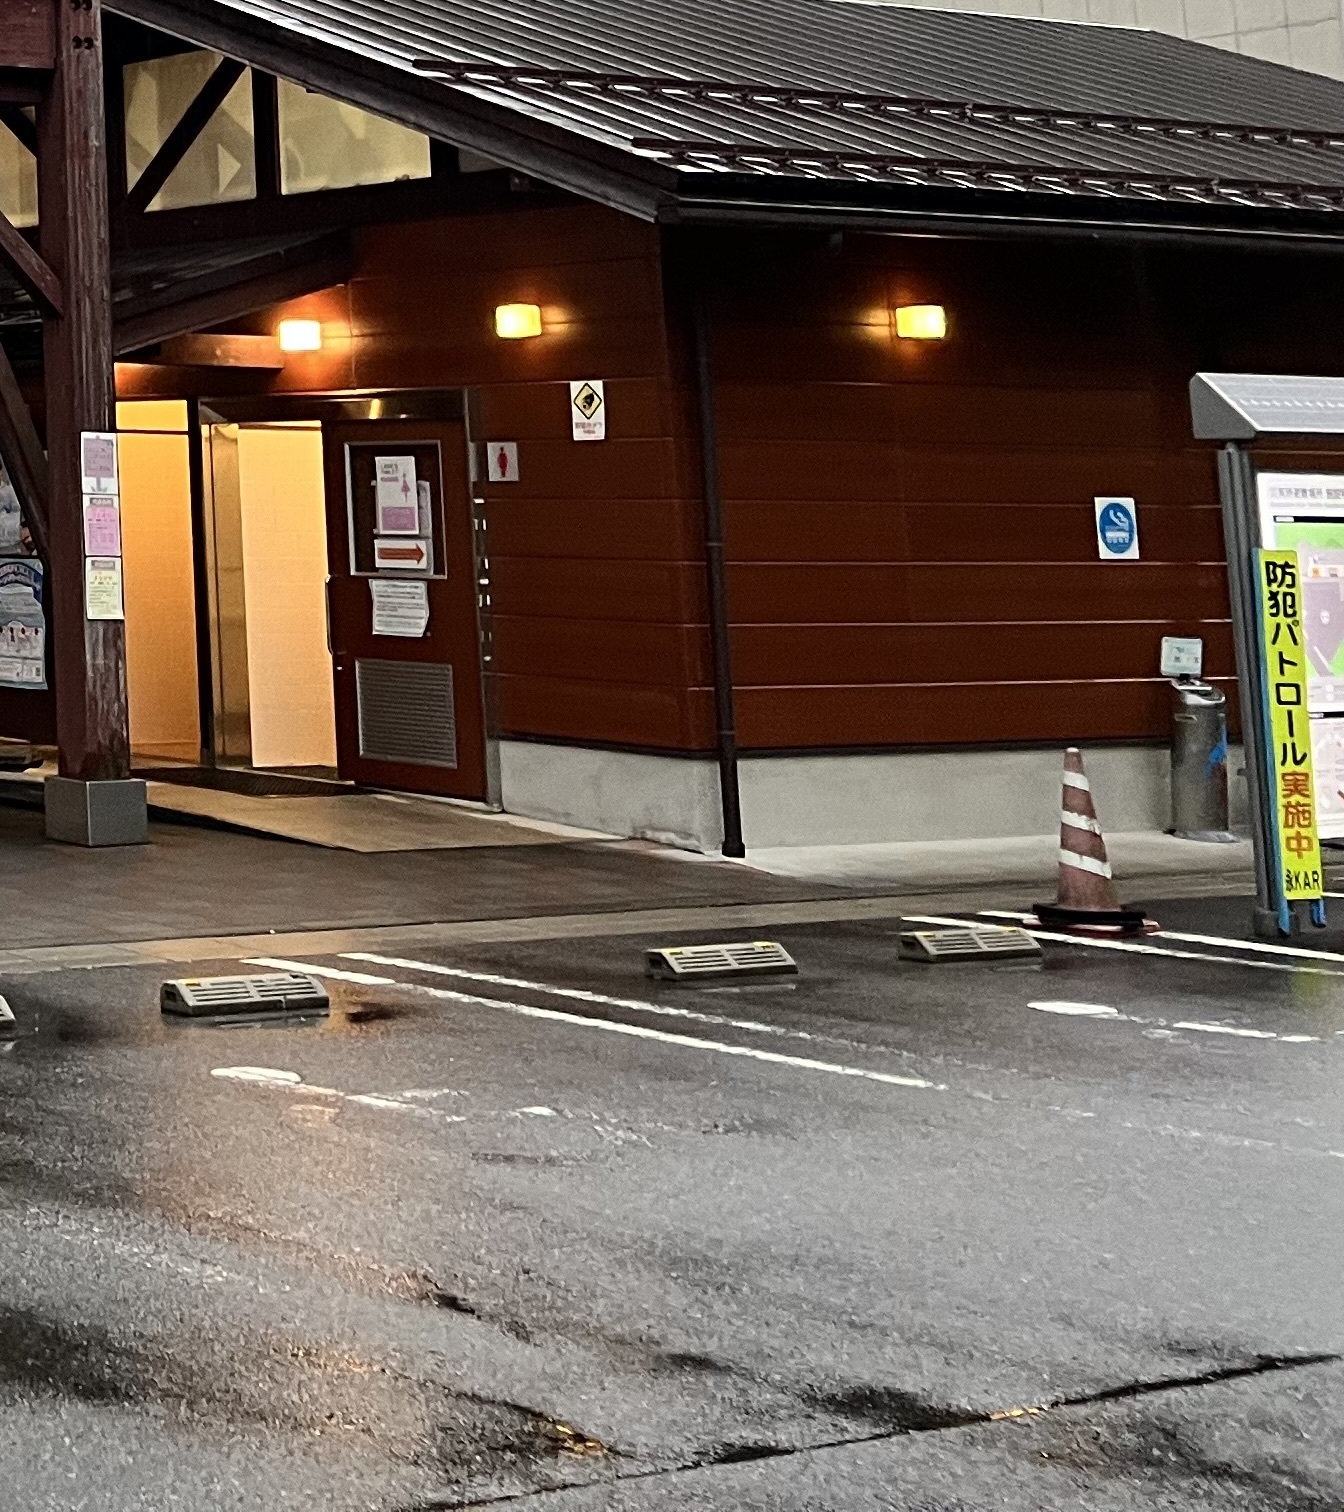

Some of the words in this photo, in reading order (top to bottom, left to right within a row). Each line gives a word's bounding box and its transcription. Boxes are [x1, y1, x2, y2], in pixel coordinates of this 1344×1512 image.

[1264, 560, 1315, 860] 防犯パトロール実施中
